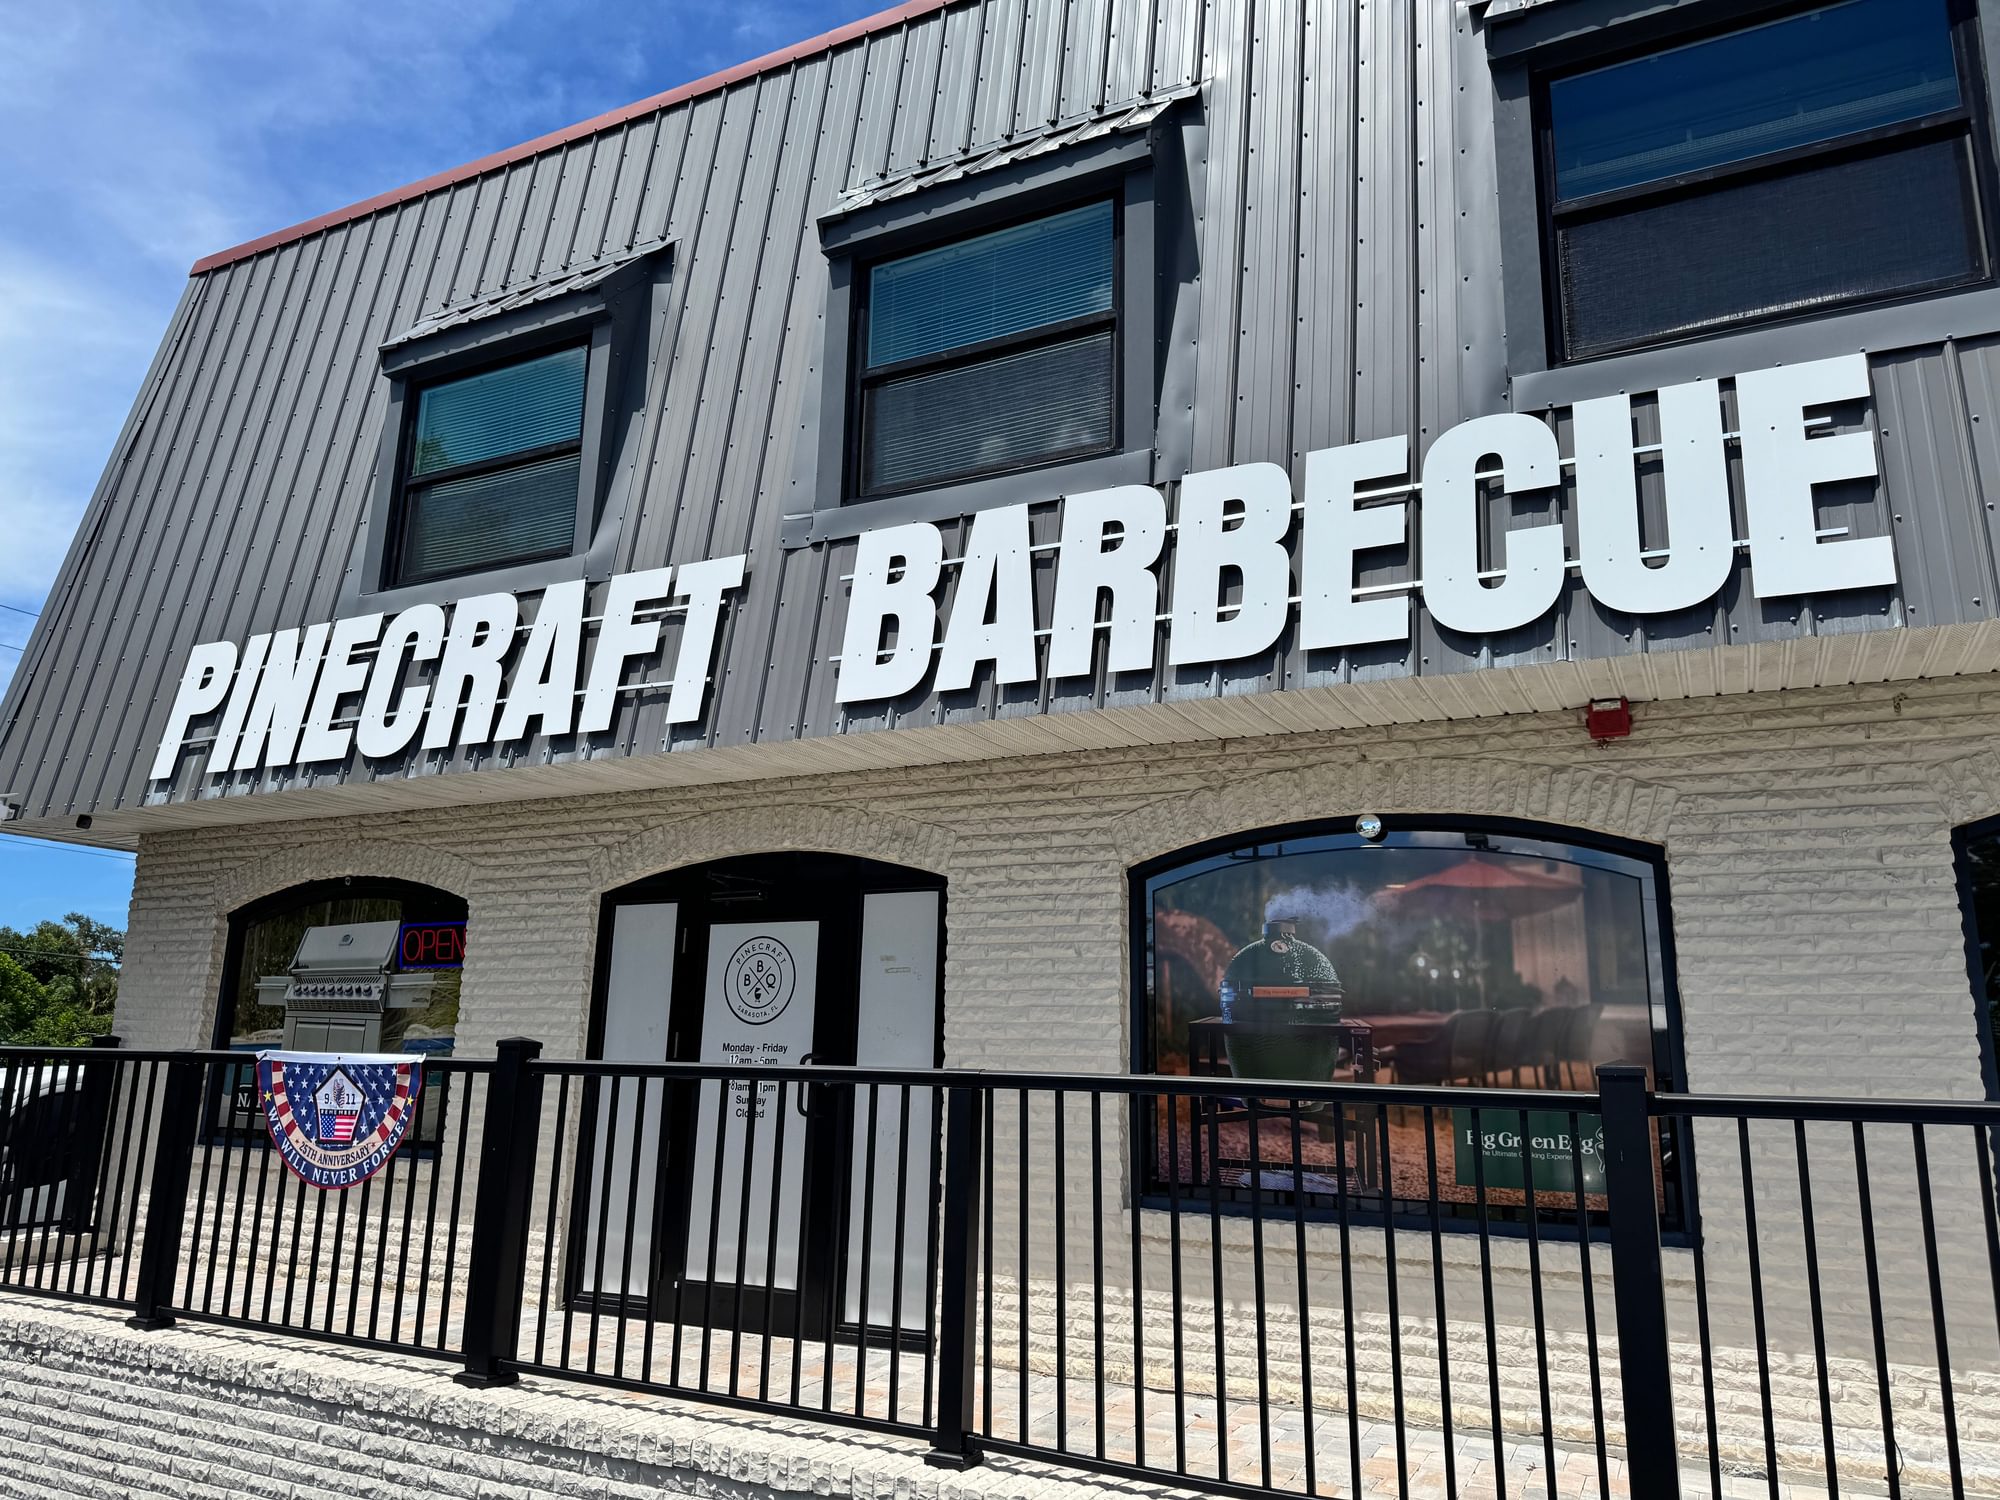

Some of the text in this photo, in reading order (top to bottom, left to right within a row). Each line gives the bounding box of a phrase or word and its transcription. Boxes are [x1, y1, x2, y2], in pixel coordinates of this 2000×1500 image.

[150, 353, 1896, 780] PINECRAFT BARBECUE
[403, 927, 467, 961] OPEN
[736, 942, 787, 965] PINECRAFT
[737, 1004, 779, 1018] SARASOTA, FL
[722, 1043, 755, 1054] Monday
[762, 1043, 788, 1054] Friday
[730, 1054, 752, 1065] 12am
[759, 1056, 778, 1065] 5pm
[758, 1081, 777, 1093] 1pm
[735, 1108, 765, 1119] Cloed
[267, 1105, 410, 1185] WE WILL NEVER FORGET
[1498, 1131, 1555, 1149] Gren
[1558, 1134, 1594, 1155] Eg
[299, 1141, 371, 1167] 25TH ANNIVERSARY
[1491, 1150, 1518, 1158] Ultimate
[1518, 1151, 1545, 1160] Cking
